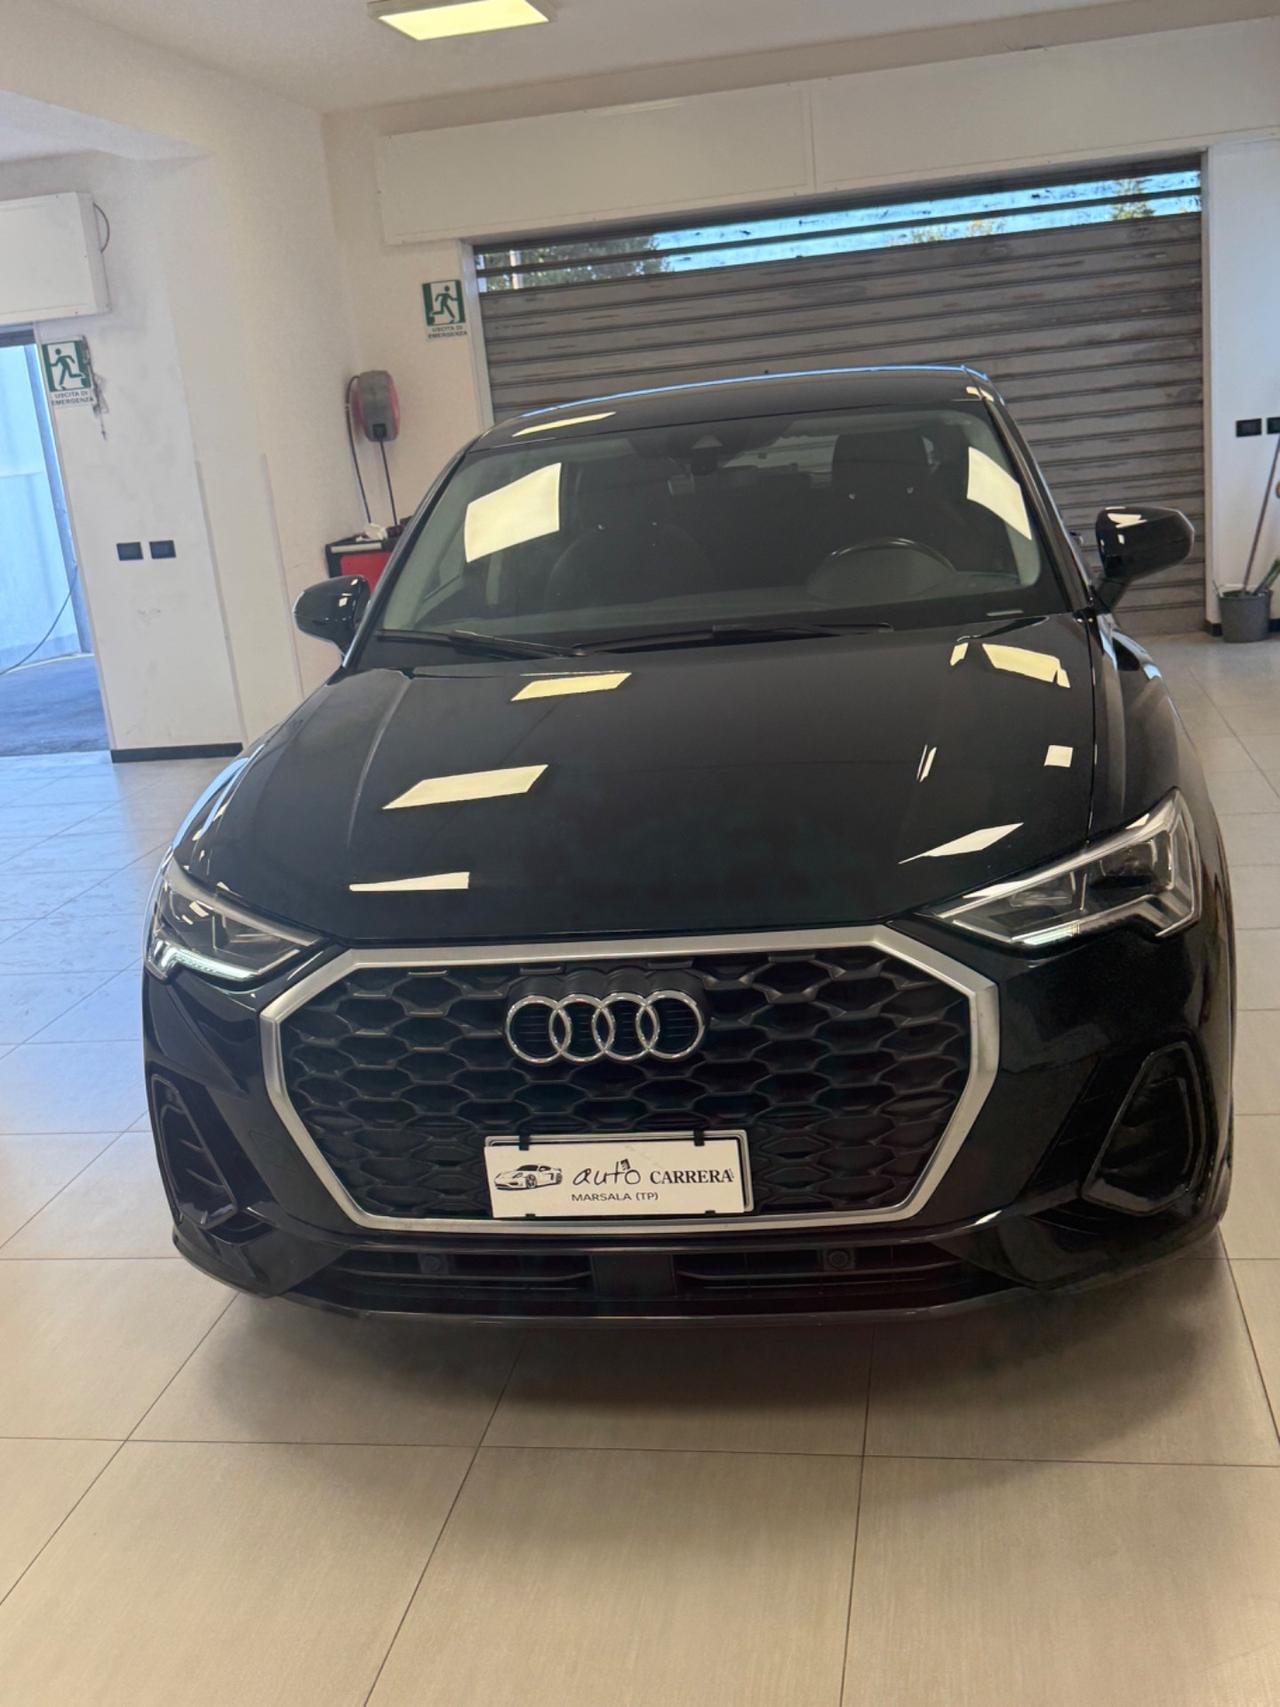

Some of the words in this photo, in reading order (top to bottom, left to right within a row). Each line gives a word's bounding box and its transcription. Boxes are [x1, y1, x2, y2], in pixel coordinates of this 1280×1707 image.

[572, 1159, 641, 1186] auto
[650, 1169, 733, 1184] CARRERA
[571, 1192, 632, 1202] MARSALA
[635, 1191, 659, 1201] (TP)
